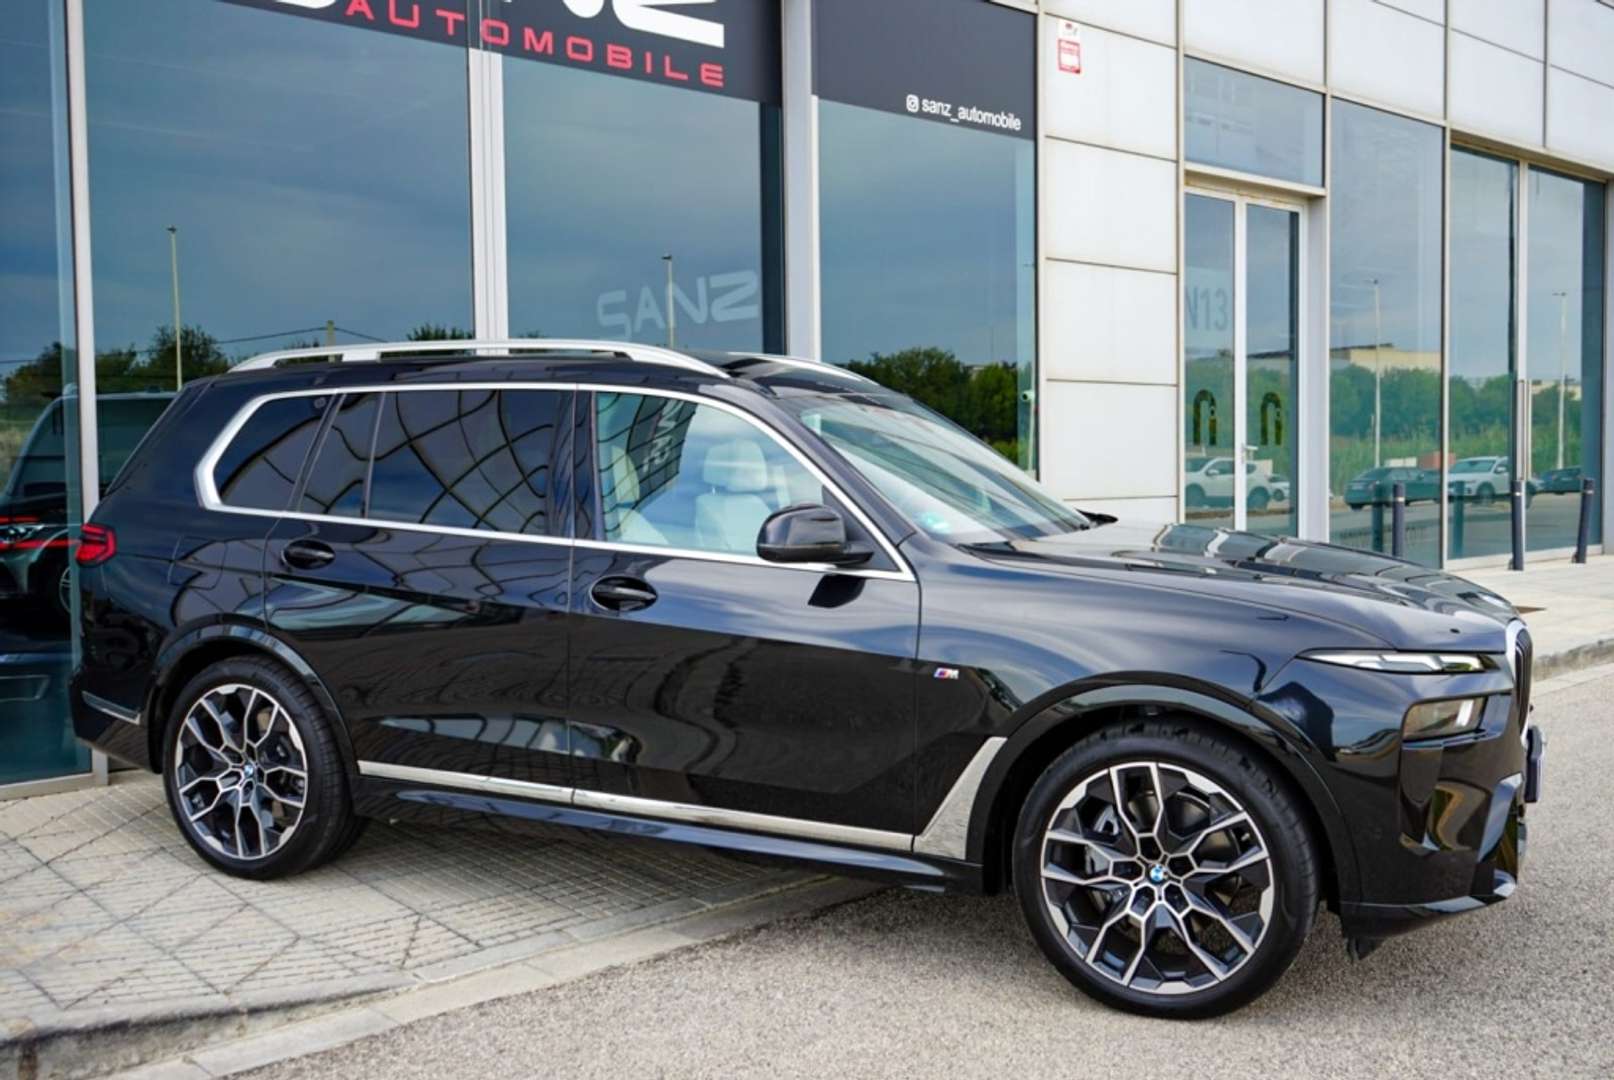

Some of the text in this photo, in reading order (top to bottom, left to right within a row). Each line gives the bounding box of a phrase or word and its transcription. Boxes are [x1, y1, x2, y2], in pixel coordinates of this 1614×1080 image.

[346, 0, 724, 87] AUTOMOBILE
[921, 98, 1021, 130] sanz_automobile
[597, 269, 760, 342] SANZ
